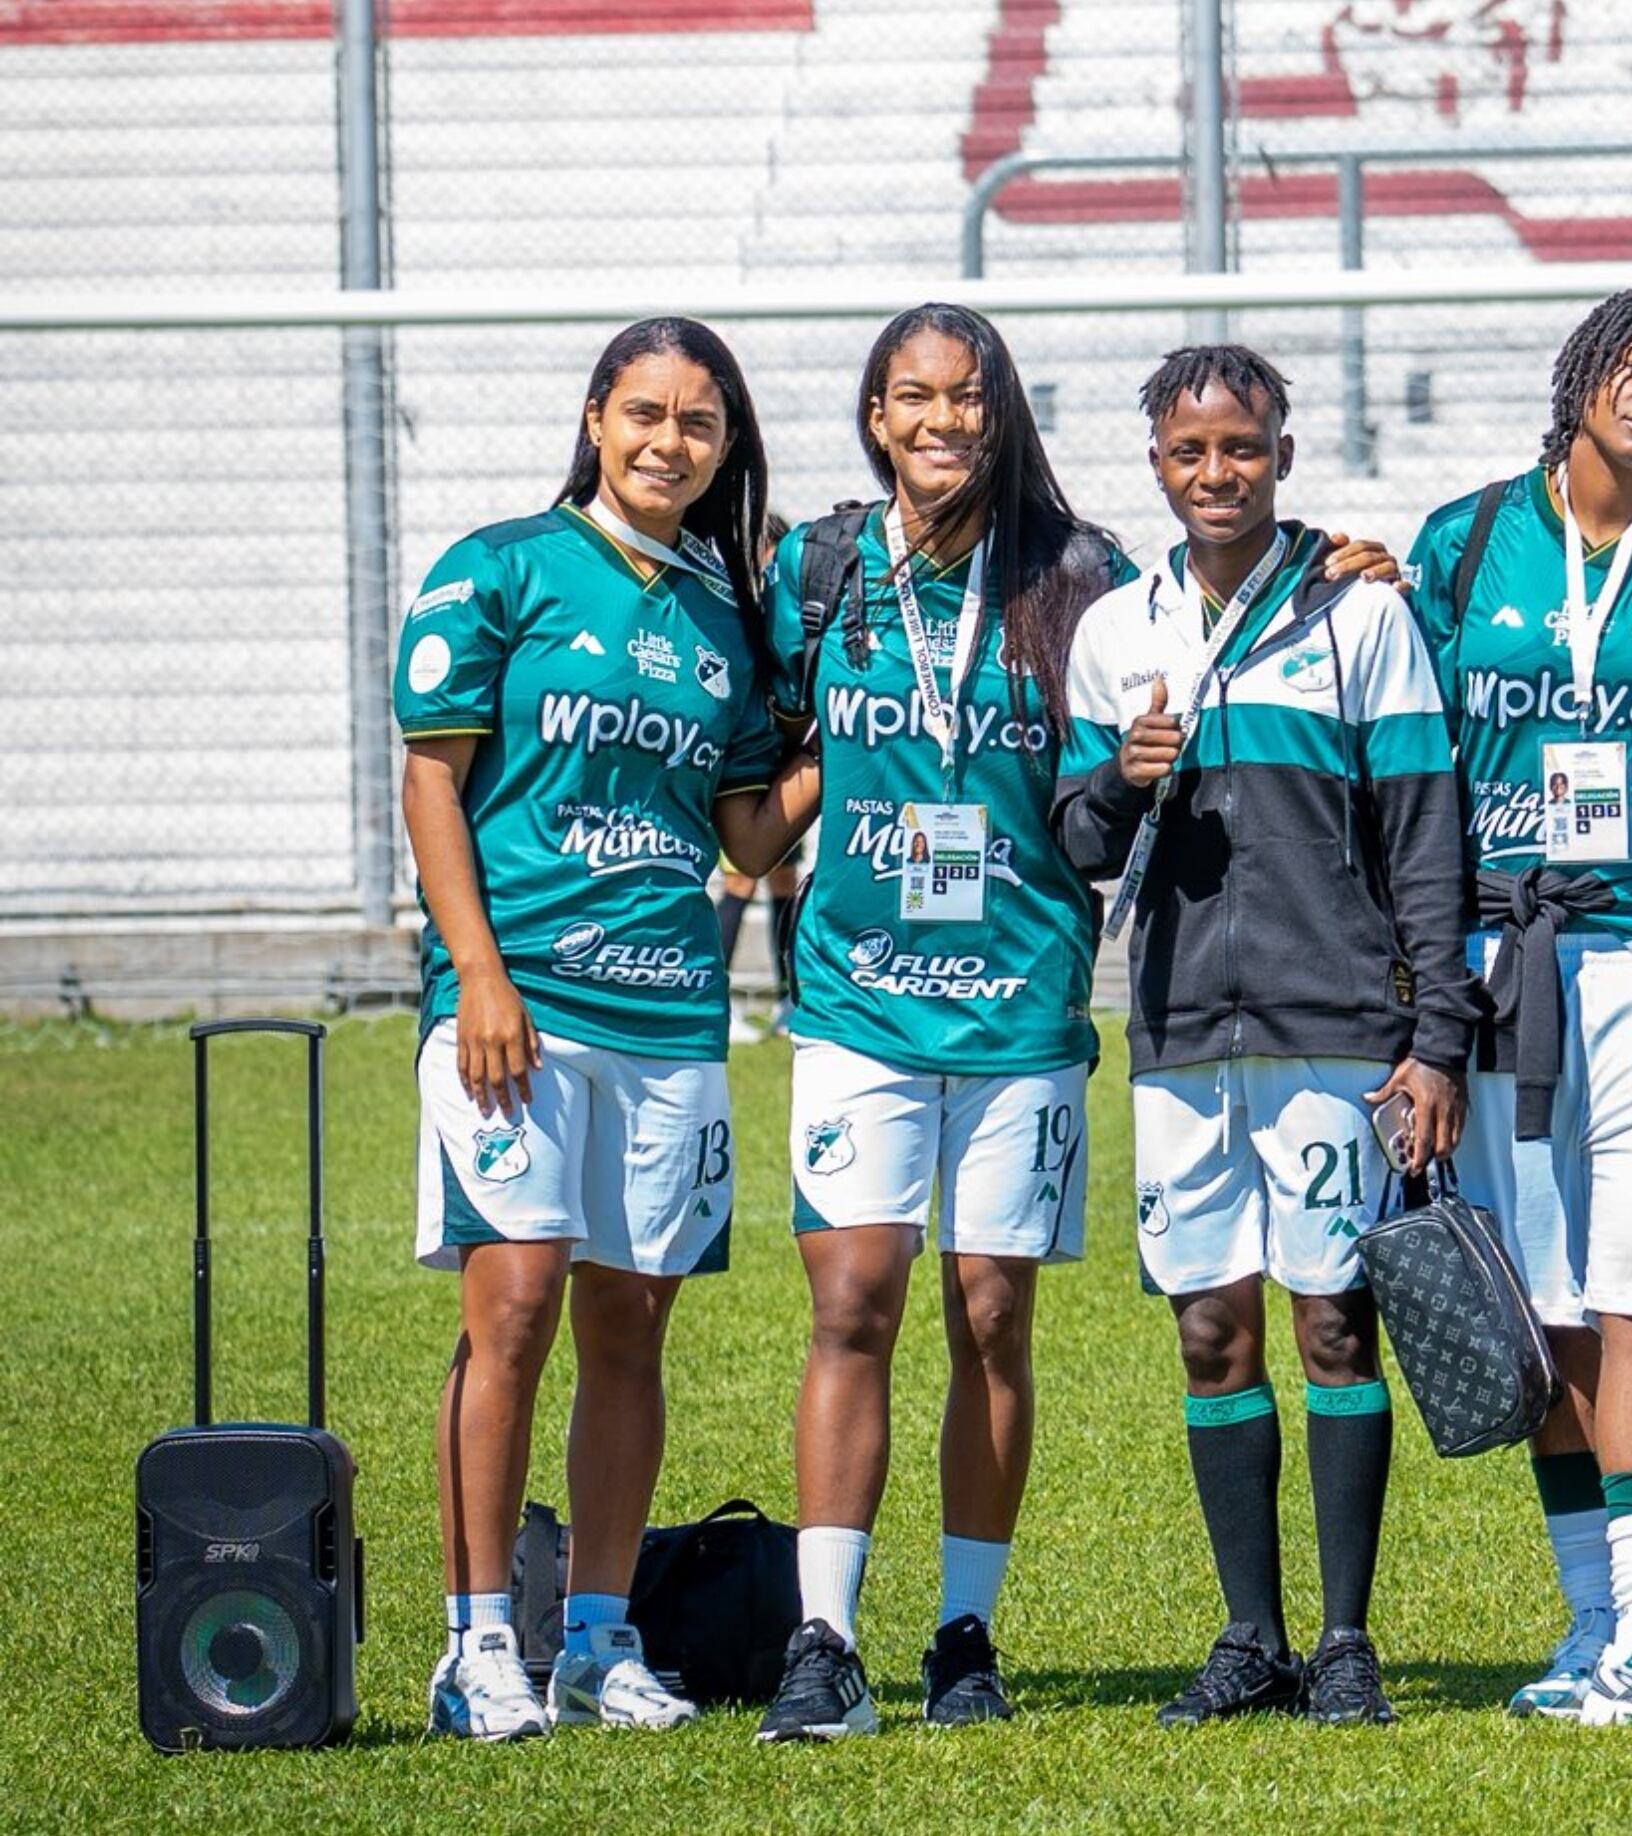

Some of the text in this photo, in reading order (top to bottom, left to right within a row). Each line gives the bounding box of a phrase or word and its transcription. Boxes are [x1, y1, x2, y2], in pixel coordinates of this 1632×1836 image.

[846, 799, 894, 816] PASTAS
[595, 943, 685, 968] FLUO
[890, 955, 986, 977] FLUO
[690, 1118, 732, 1191] 13
[1030, 1104, 1072, 1173] 19
[1301, 1138, 1364, 1210] 21
